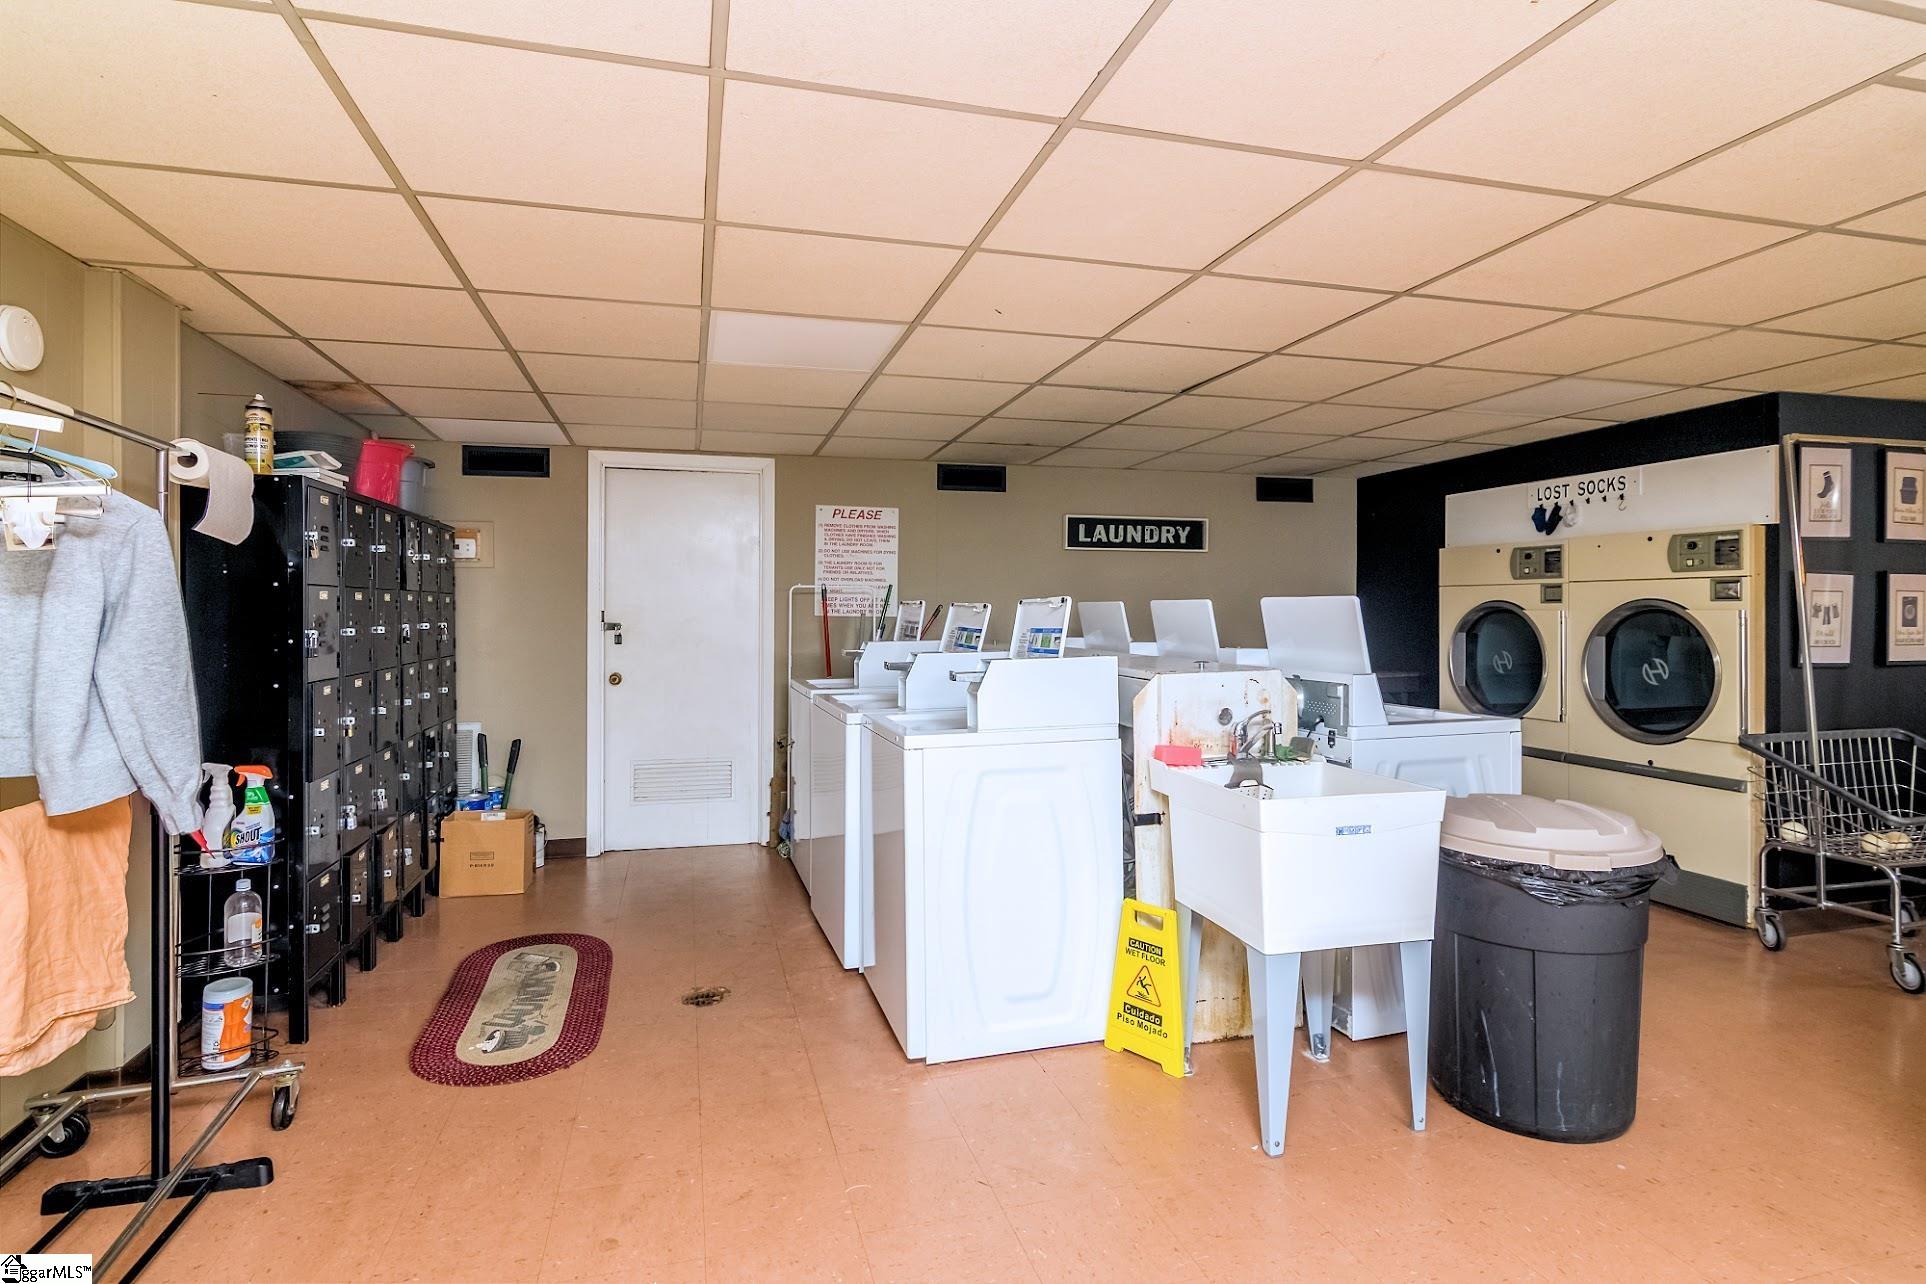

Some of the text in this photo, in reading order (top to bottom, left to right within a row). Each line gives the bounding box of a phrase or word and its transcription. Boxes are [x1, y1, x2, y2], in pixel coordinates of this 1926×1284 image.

[1538, 476, 1626, 501] LOST SOCKS
[832, 508, 882, 520] PLEASE
[1078, 524, 1190, 544] LAUNDRY
[236, 826, 262, 845] SHOUT
[1129, 939, 1162, 956] CAUTION
[1126, 948, 1166, 967] WET FLOOR
[1124, 1004, 1161, 1025] Cuidado
[1117, 1012, 1168, 1039] Piso Mojado
